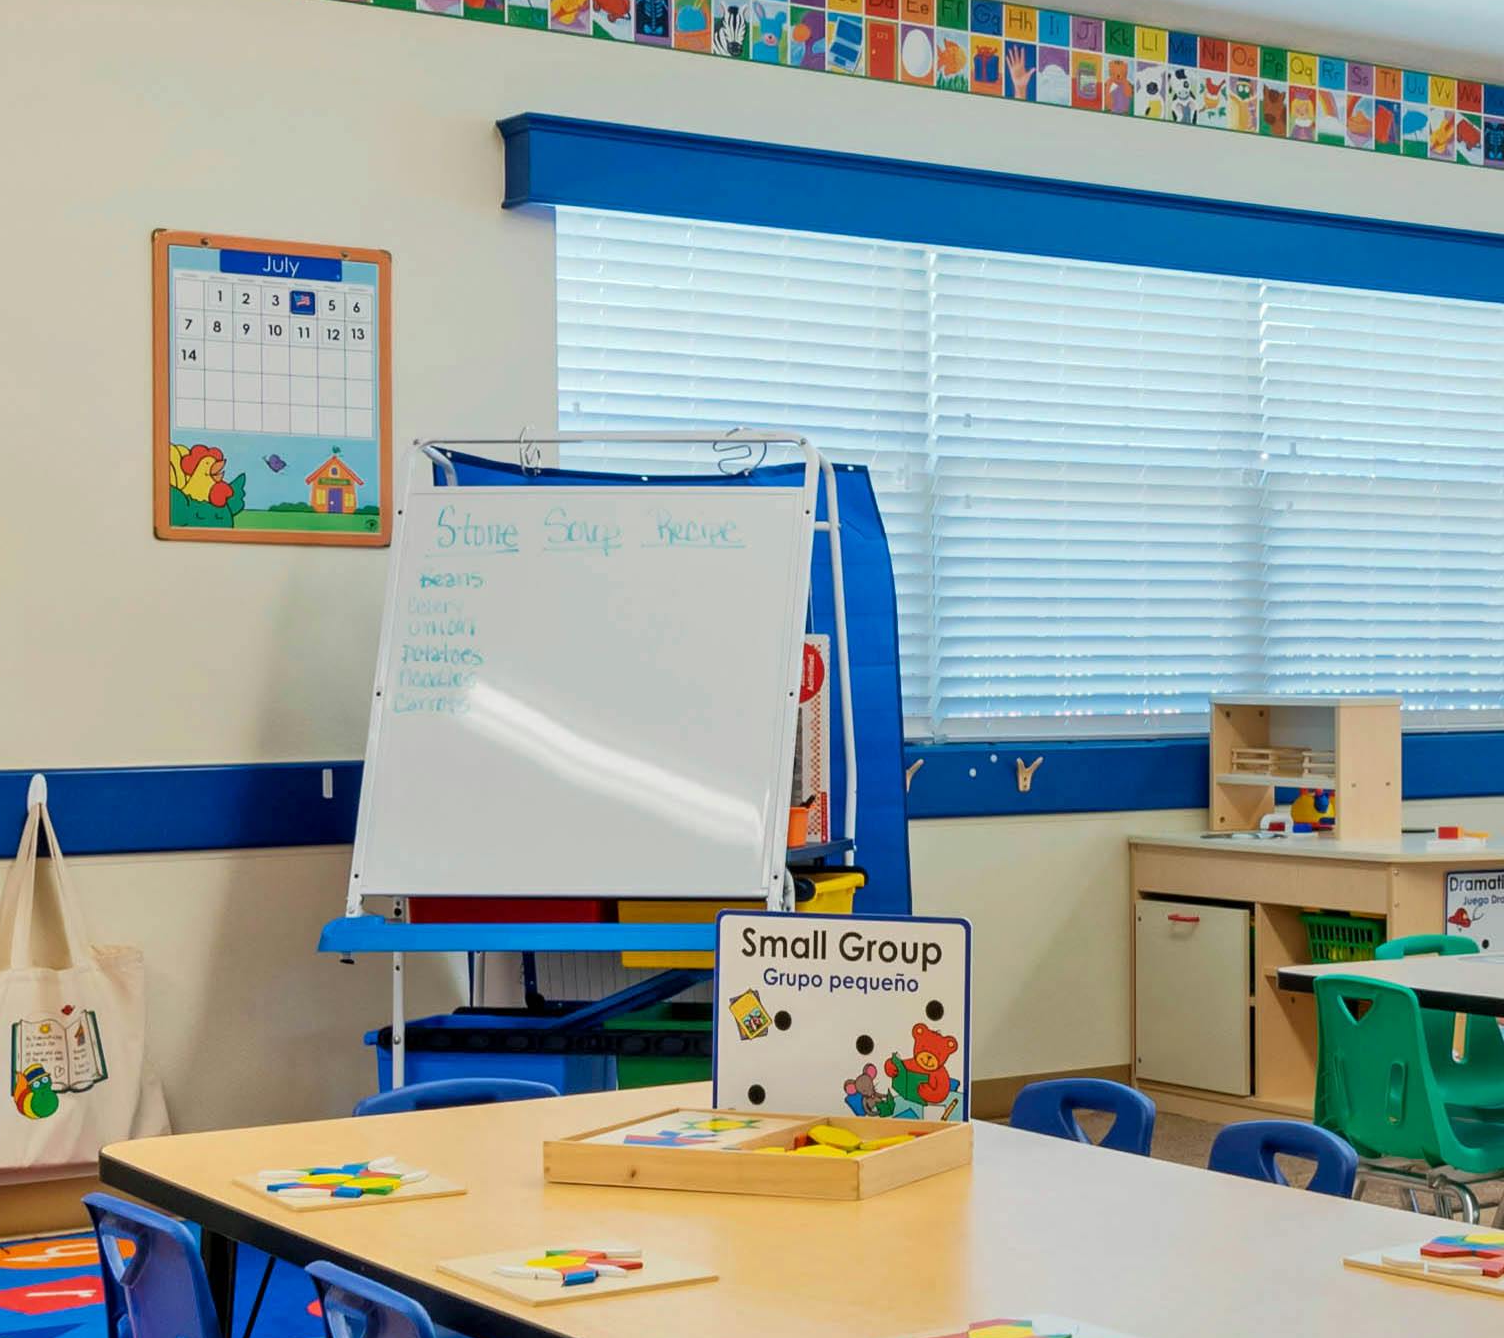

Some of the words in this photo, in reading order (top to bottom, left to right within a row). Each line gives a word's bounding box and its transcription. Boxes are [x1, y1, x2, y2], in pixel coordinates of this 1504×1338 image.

[261, 256, 300, 278] July
[217, 290, 223, 302] 1
[242, 294, 250, 305] 2
[272, 295, 279, 306] 3
[328, 300, 336, 311] 5
[353, 302, 360, 313] 6
[185, 319, 192, 330] 7
[213, 321, 221, 333] 8
[242, 324, 250, 335] 9
[268, 325, 282, 337] 10
[298, 326, 311, 338] 11
[326, 328, 340, 341] 12
[351, 327, 365, 340] 13
[181, 349, 197, 361] 14
[1464, 895, 1489, 906] Juego
[741, 927, 827, 960] Small
[839, 932, 942, 972] Group
[763, 968, 823, 990] Grupo
[829, 973, 919, 994] pequeño
